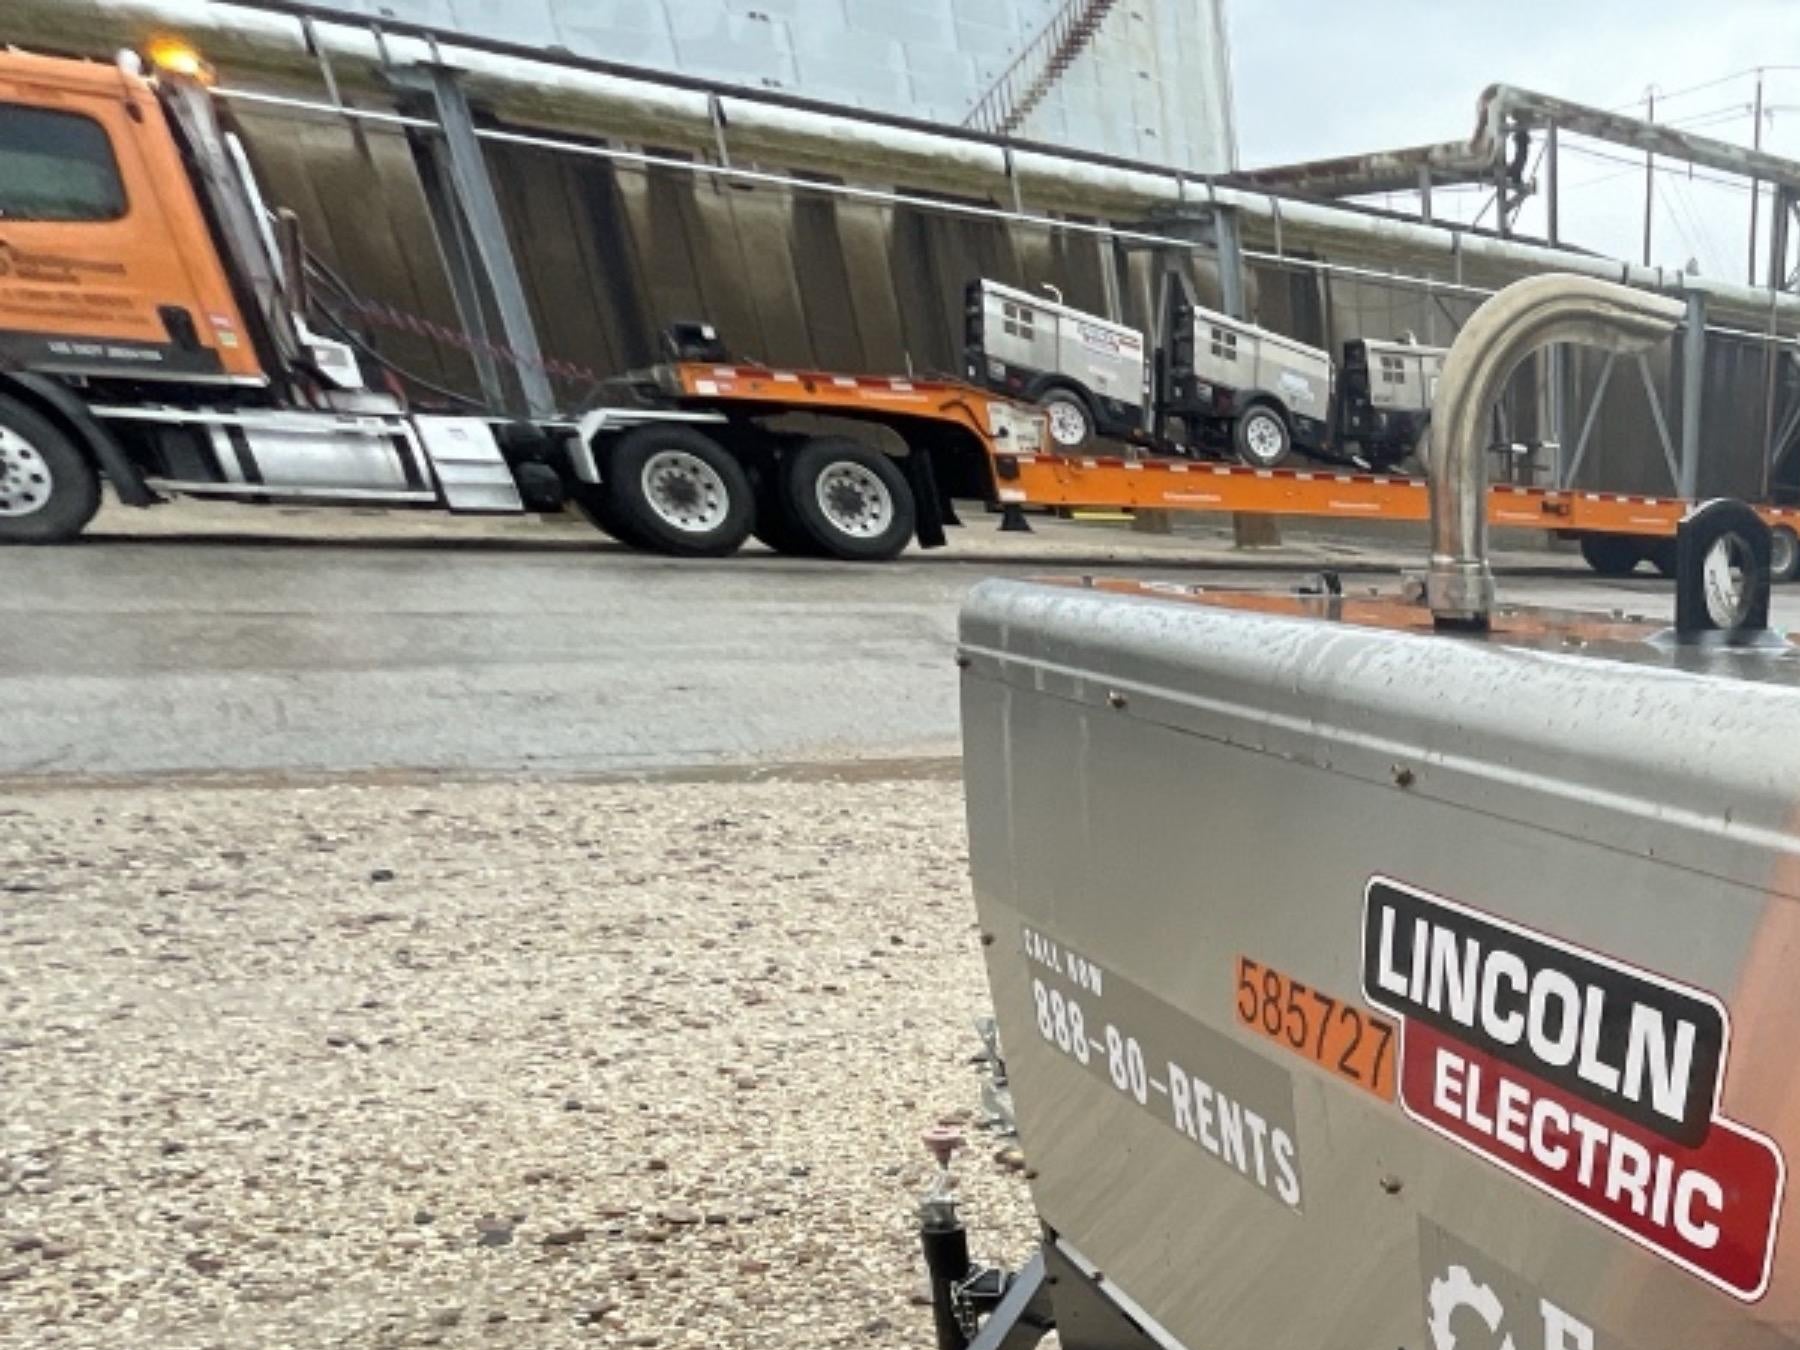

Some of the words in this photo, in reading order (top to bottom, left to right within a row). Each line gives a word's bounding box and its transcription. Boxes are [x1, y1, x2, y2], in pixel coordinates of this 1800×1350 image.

[1024, 929, 1063, 973] CALL
[1066, 953, 1103, 996] NOW
[1238, 957, 1394, 1090] 585727
[1377, 907, 1697, 1122] LINCOLN
[1032, 978, 1300, 1206] 888-80-RENTS
[1433, 1046, 1725, 1250] ELECTRIC
